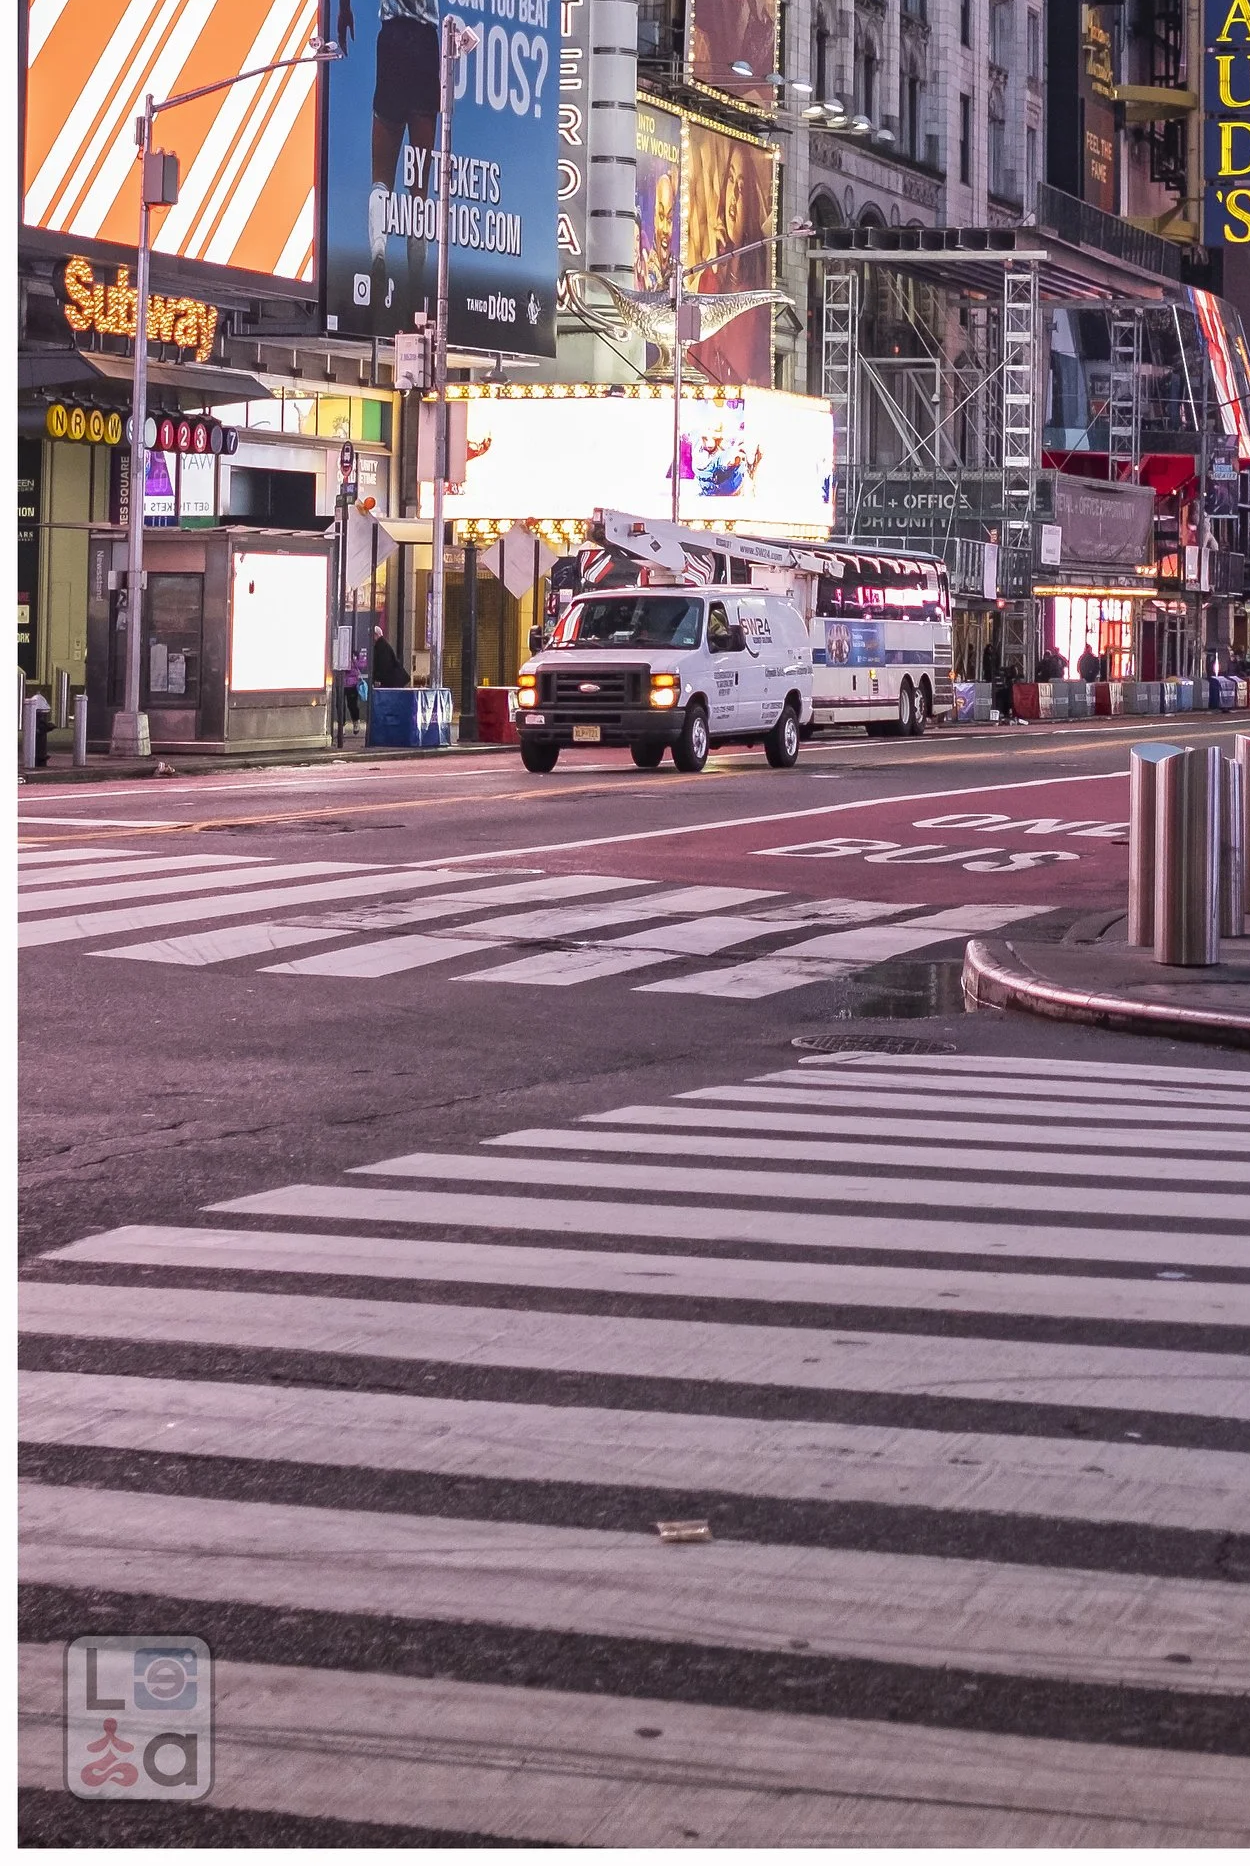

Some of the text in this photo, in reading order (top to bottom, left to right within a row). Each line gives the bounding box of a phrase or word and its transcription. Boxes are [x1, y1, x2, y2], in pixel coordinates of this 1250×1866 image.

[638, 113, 655, 134] INTO
[636, 132, 650, 153] EW
[1086, 130, 1112, 161] FEEL THE
[404, 144, 501, 204] BY TCKETS
[1091, 159, 1107, 184] FAME
[379, 190, 522, 258] TANGO10S.COM
[63, 253, 219, 364] Subway
[467, 297, 488, 313] TANGO
[119, 455, 130, 508] SQUARE
[903, 493, 969, 509] OFFICE
[739, 545, 783, 561] www.SW24.com
[741, 618, 771, 635] SW24
[911, 813, 1131, 837] ONL
[748, 837, 1081, 872] BUS
